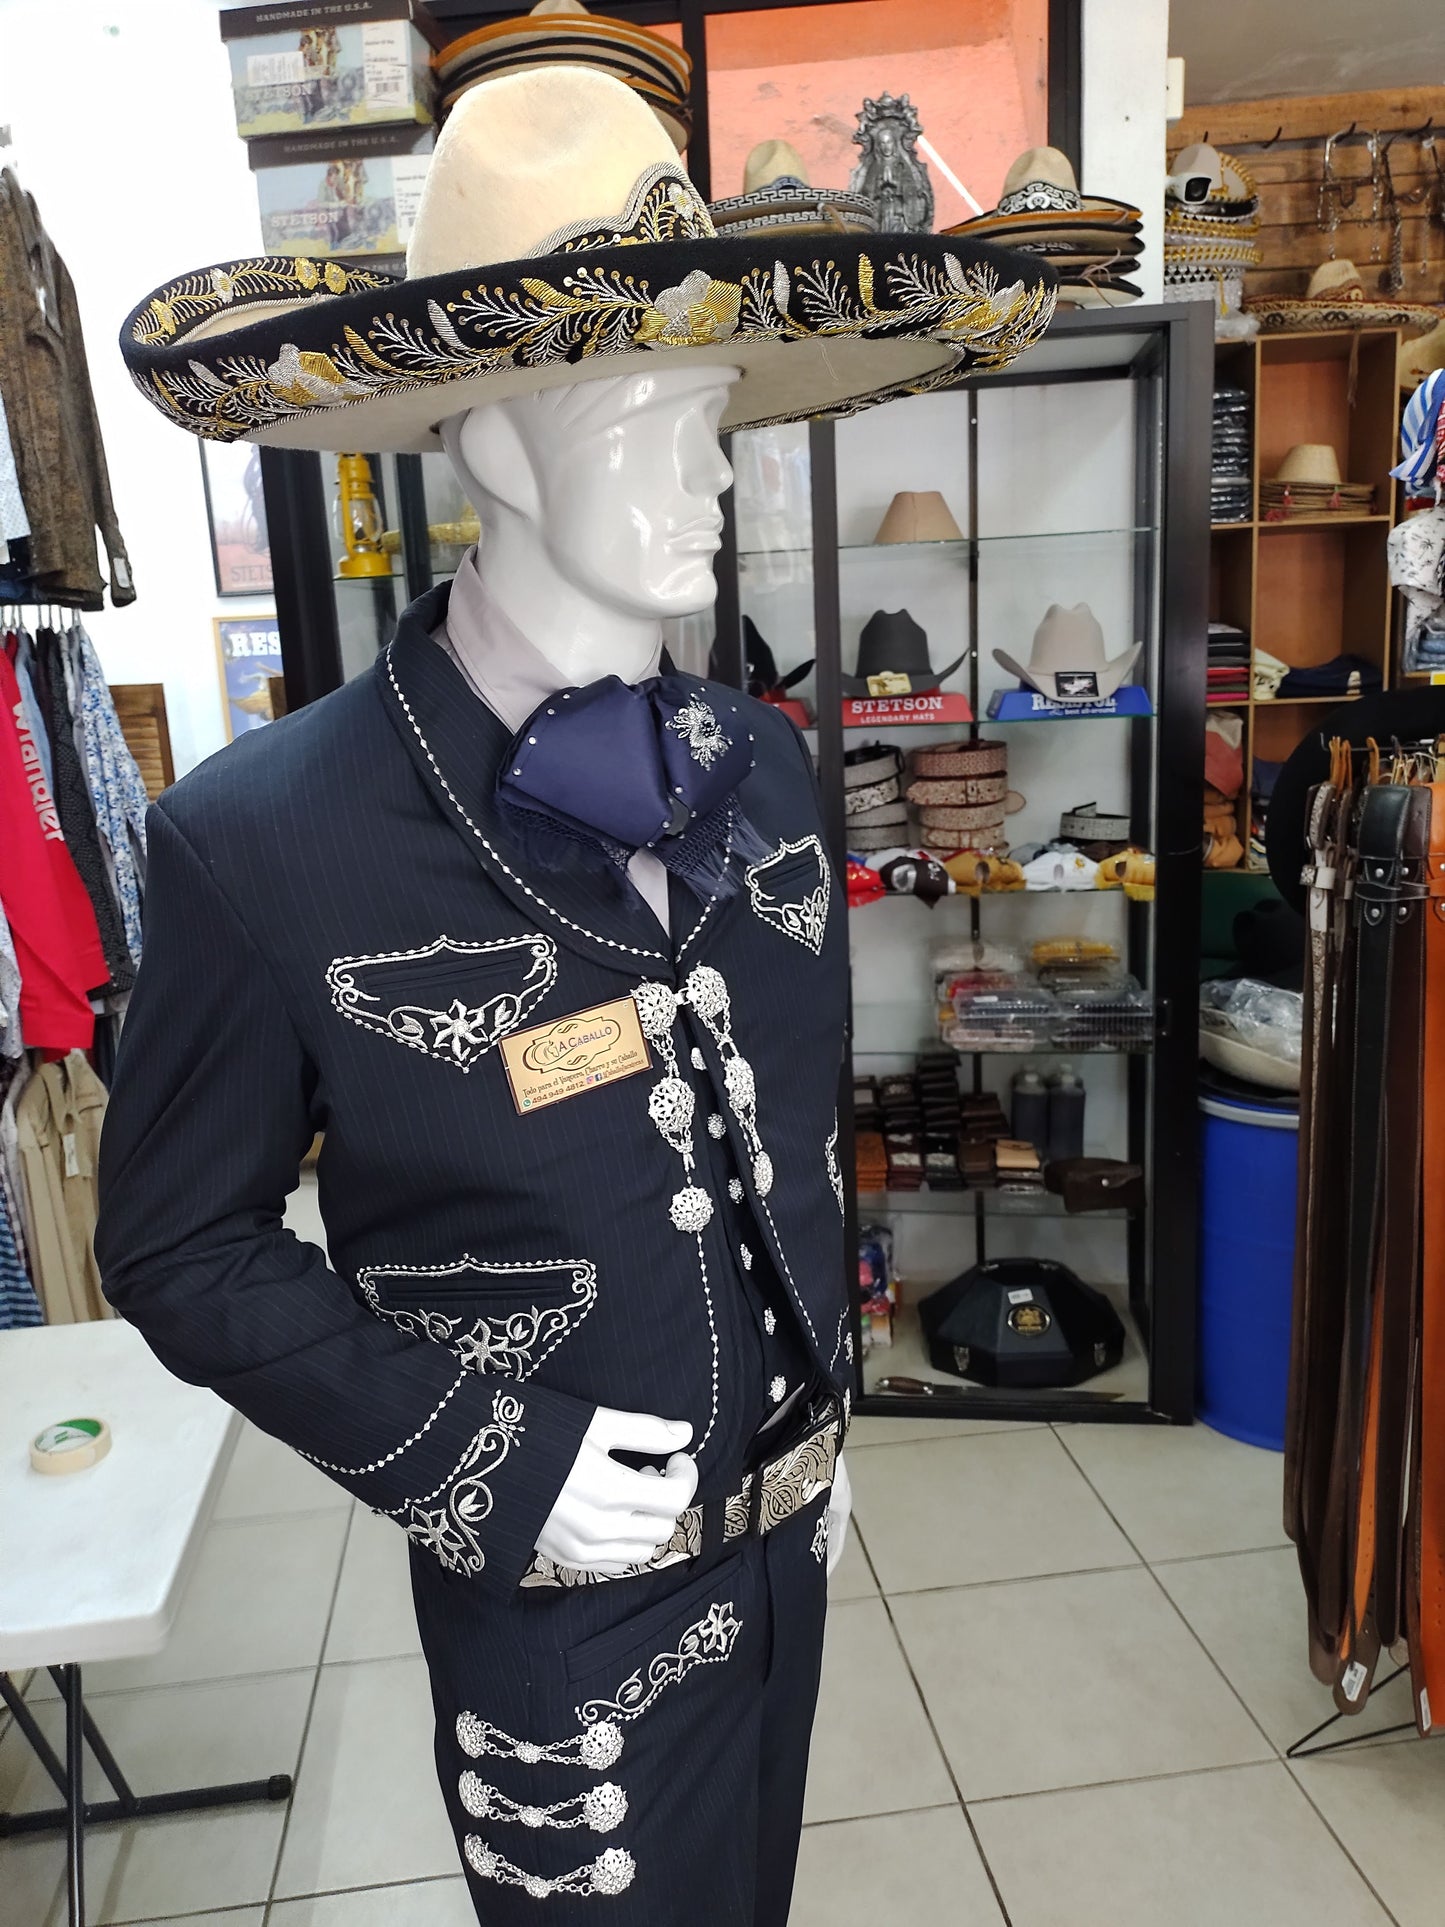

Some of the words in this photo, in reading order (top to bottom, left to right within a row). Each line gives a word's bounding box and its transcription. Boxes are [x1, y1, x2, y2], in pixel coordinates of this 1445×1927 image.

[256, 9, 309, 22] HANDMADE
[311, 7, 321, 16] IN
[324, 5, 342, 14] THE
[344, 2, 373, 12] U.S.A.
[284, 141, 337, 153] HANDMADE
[338, 140, 349, 148] IN
[351, 138, 368, 147] THE
[271, 211, 339, 228] STETSON
[852, 696, 944, 715] STETSON
[860, 714, 909, 725] LEGENDARY
[912, 713, 935, 723] HATS
[559, 1041, 567, 1051] A
[522, 1087, 537, 1098] Todo
[538, 1083, 552, 1093] para
[553, 1078, 559, 1086] el
[585, 1064, 605, 1076] Charro
[618, 1050, 638, 1063] Caballo
[532, 1094, 548, 1104] 494
[548, 1088, 564, 1099] 949
[566, 1081, 585, 1092] 4812
